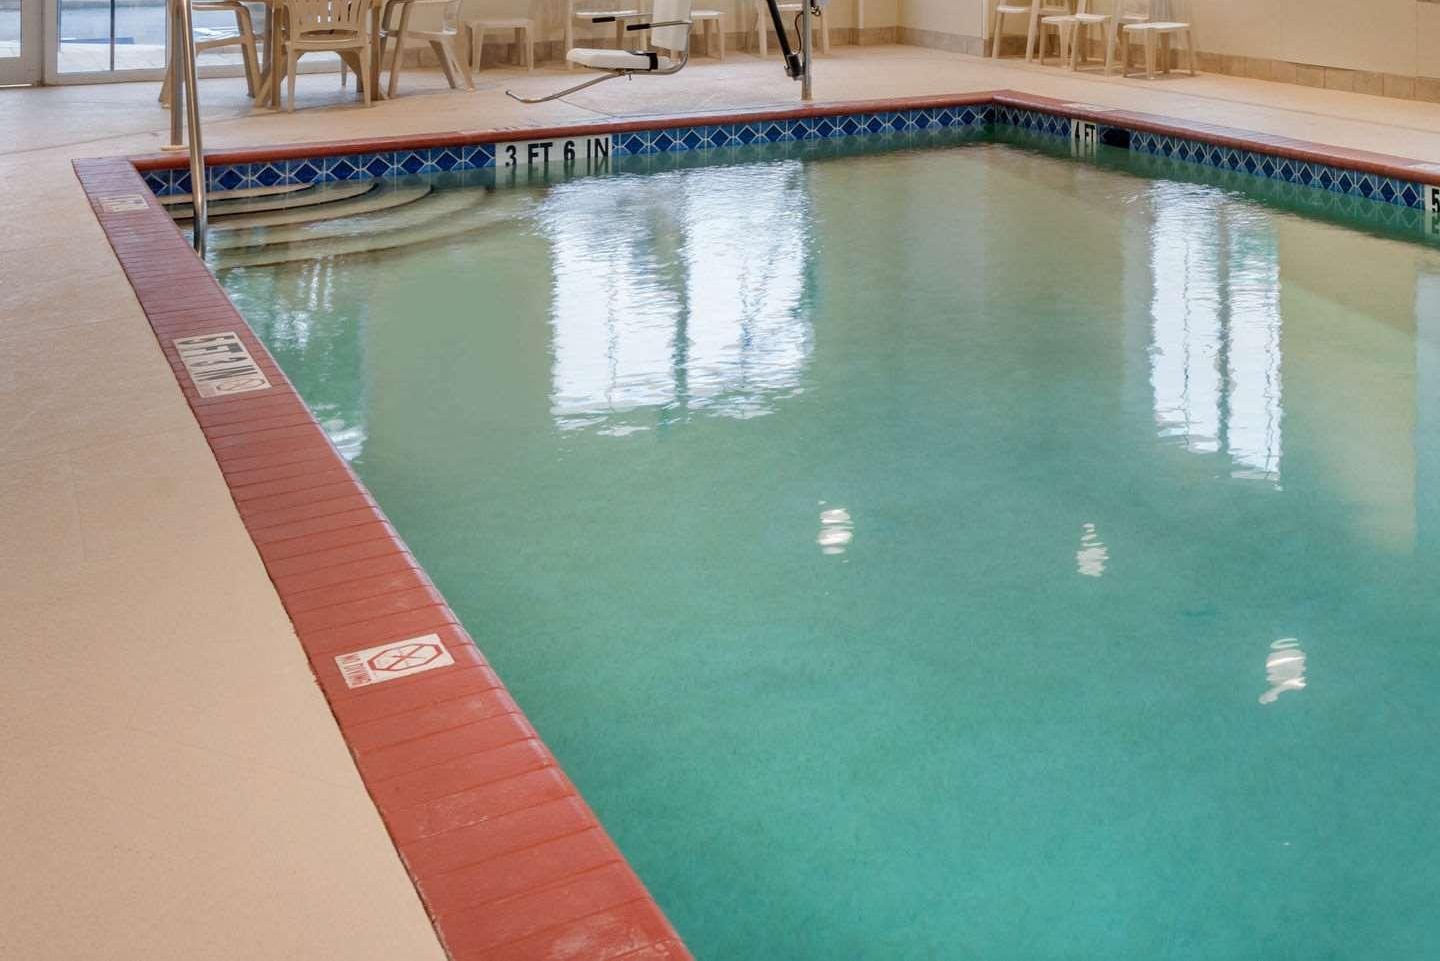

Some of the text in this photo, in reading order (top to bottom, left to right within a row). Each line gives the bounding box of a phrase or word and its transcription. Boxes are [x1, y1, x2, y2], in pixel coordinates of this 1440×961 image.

[1084, 123, 1096, 143] FT
[505, 138, 609, 167] 3 FT 6 IN
[1432, 188, 1440, 214] 5
[181, 342, 244, 358] FT
[193, 364, 259, 382] IN
